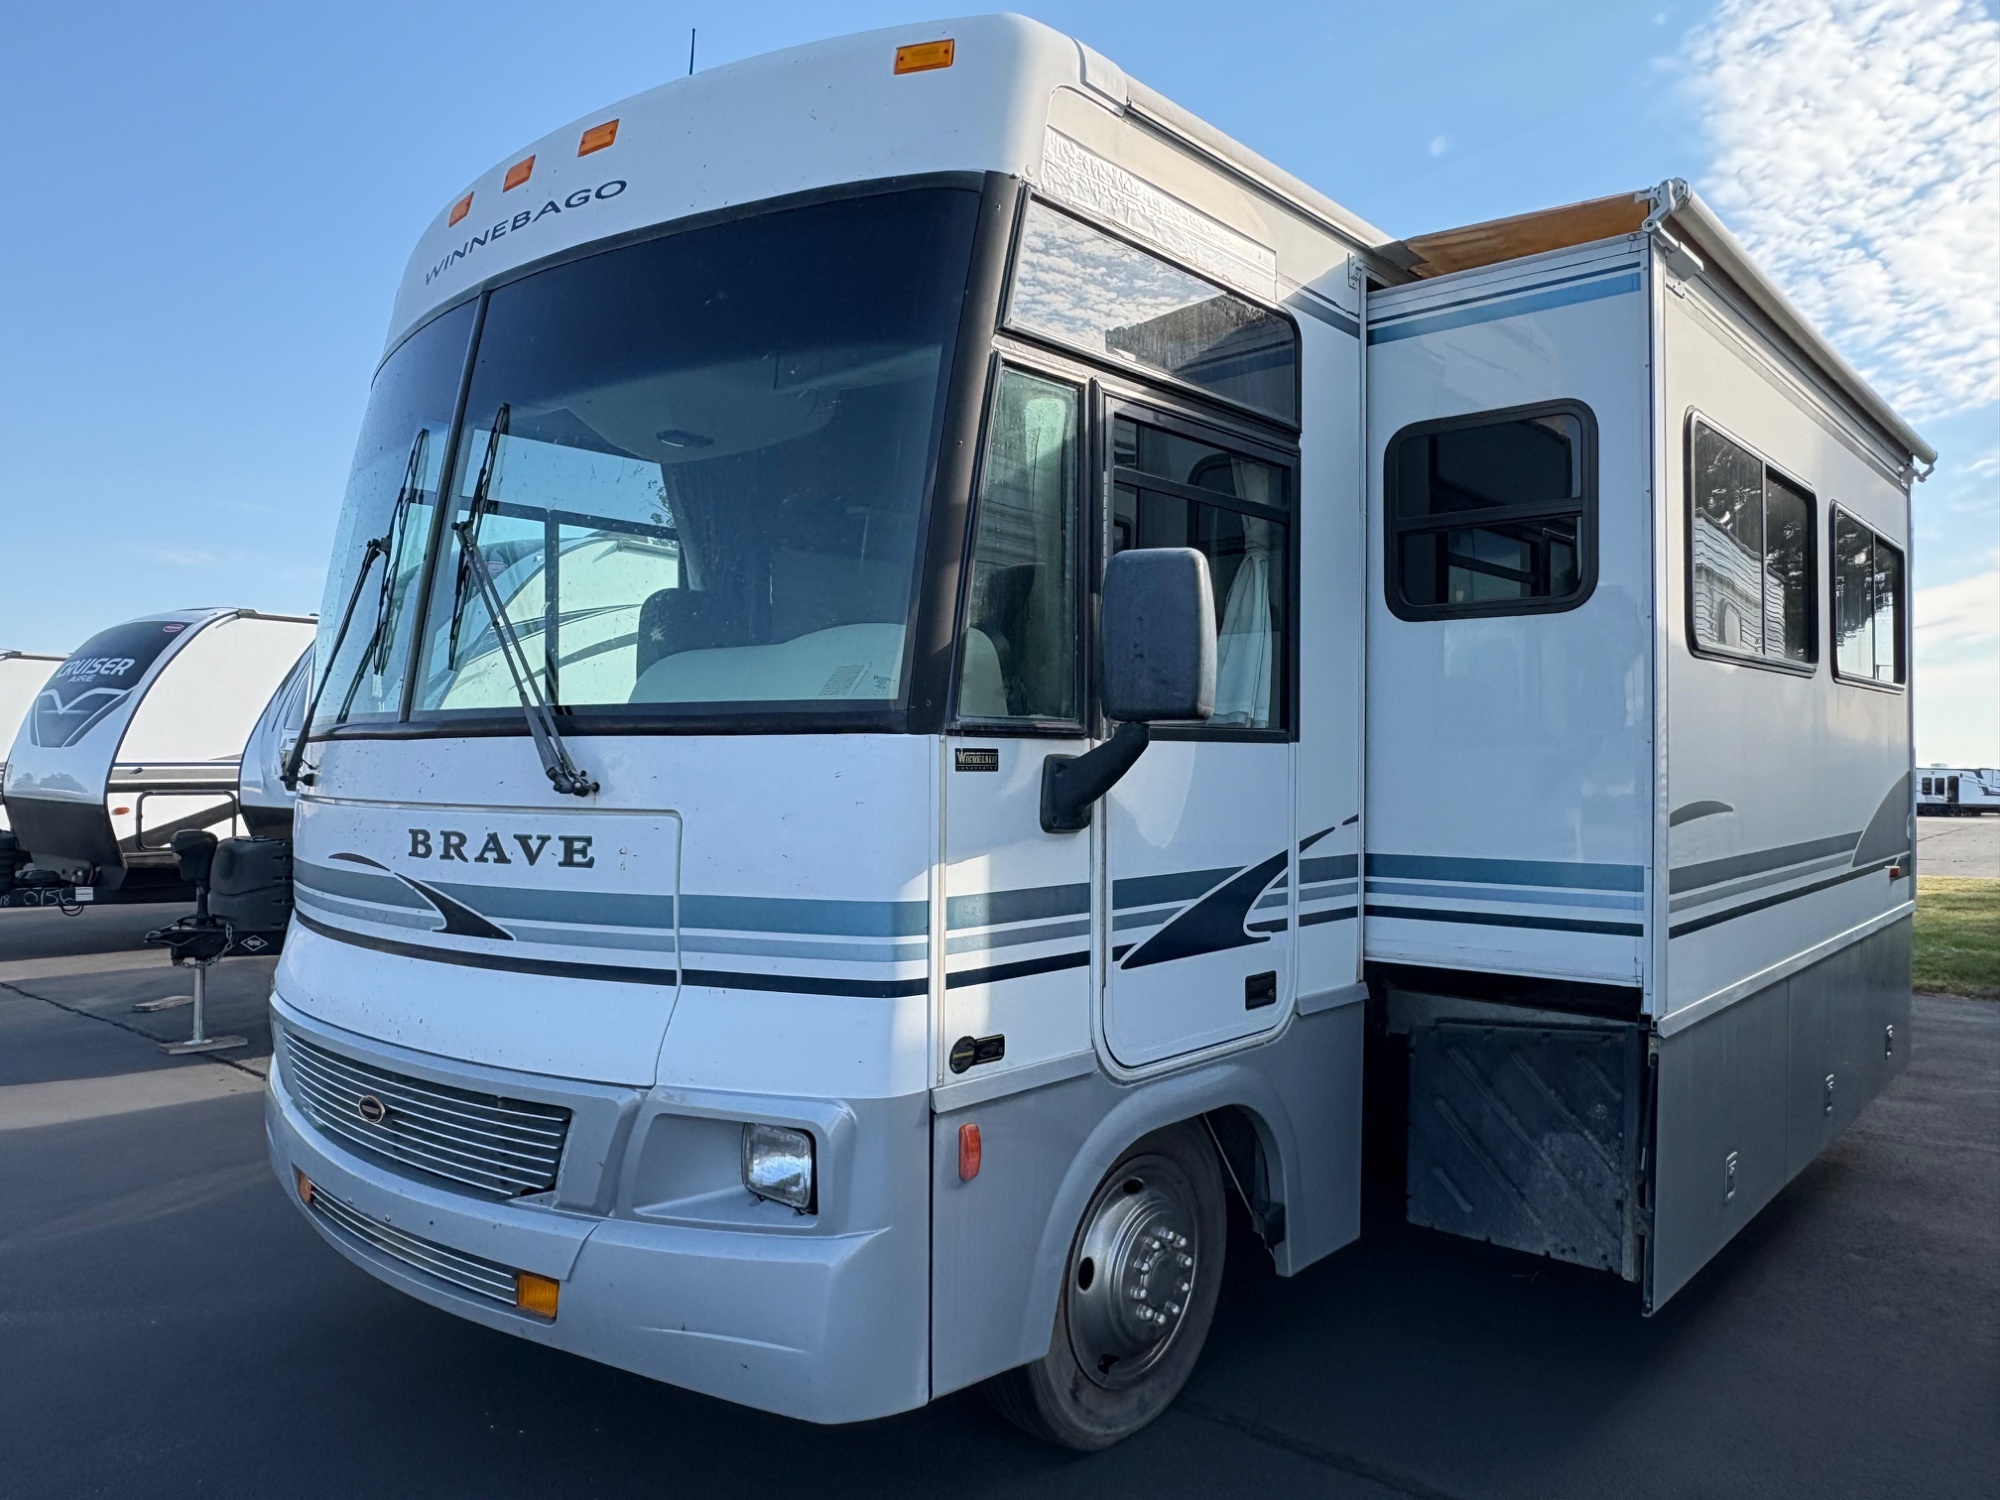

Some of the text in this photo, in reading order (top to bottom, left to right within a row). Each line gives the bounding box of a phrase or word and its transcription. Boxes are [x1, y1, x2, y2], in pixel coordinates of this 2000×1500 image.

[426, 180, 627, 285] WINNEBAGO
[56, 658, 135, 678] CRUISER
[408, 828, 595, 868] BRAVE
